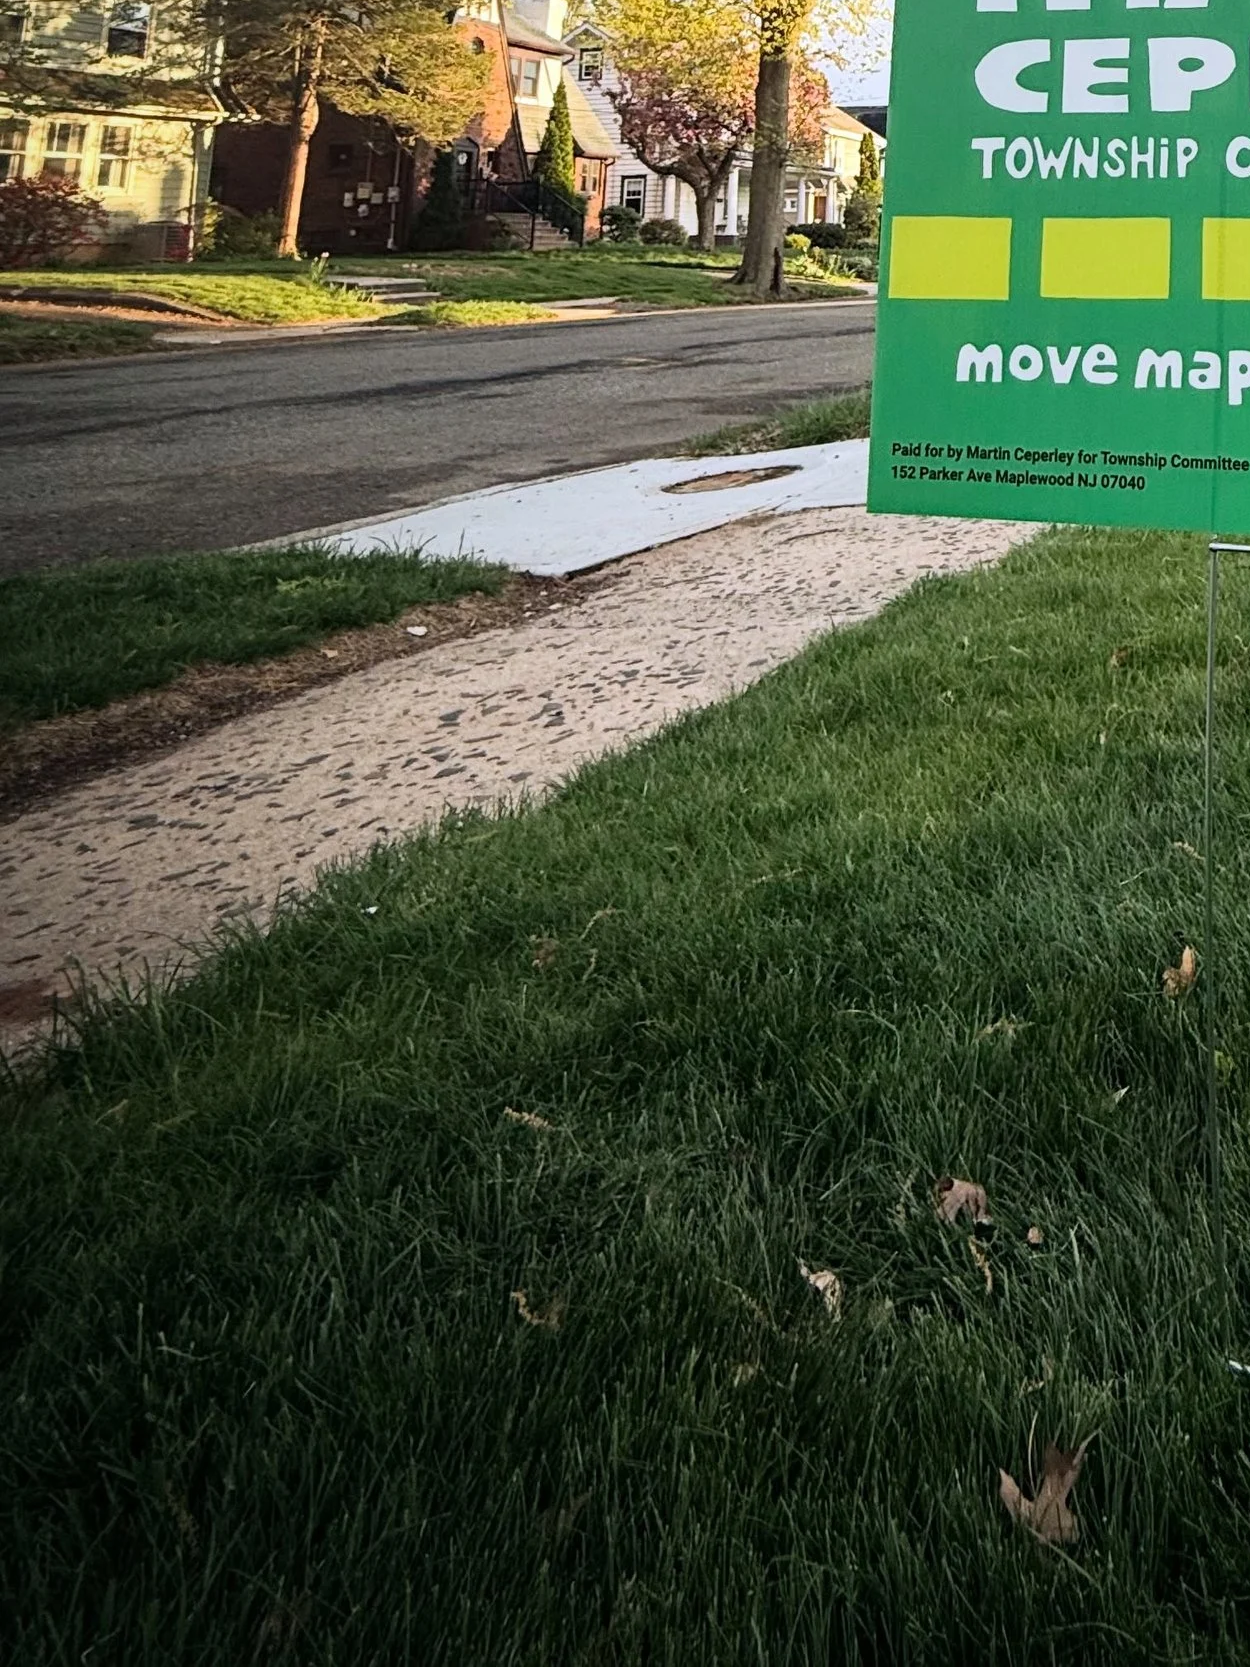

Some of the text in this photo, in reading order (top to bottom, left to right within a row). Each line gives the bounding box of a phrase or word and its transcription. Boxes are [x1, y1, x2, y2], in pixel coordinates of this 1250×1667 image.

[956, 343, 1118, 385] move
[891, 442, 1250, 472] Paid for by Martin Ceperley for Township Committee
[891, 465, 1146, 491] 152 Parker Ave Maplewood NJ 07040
